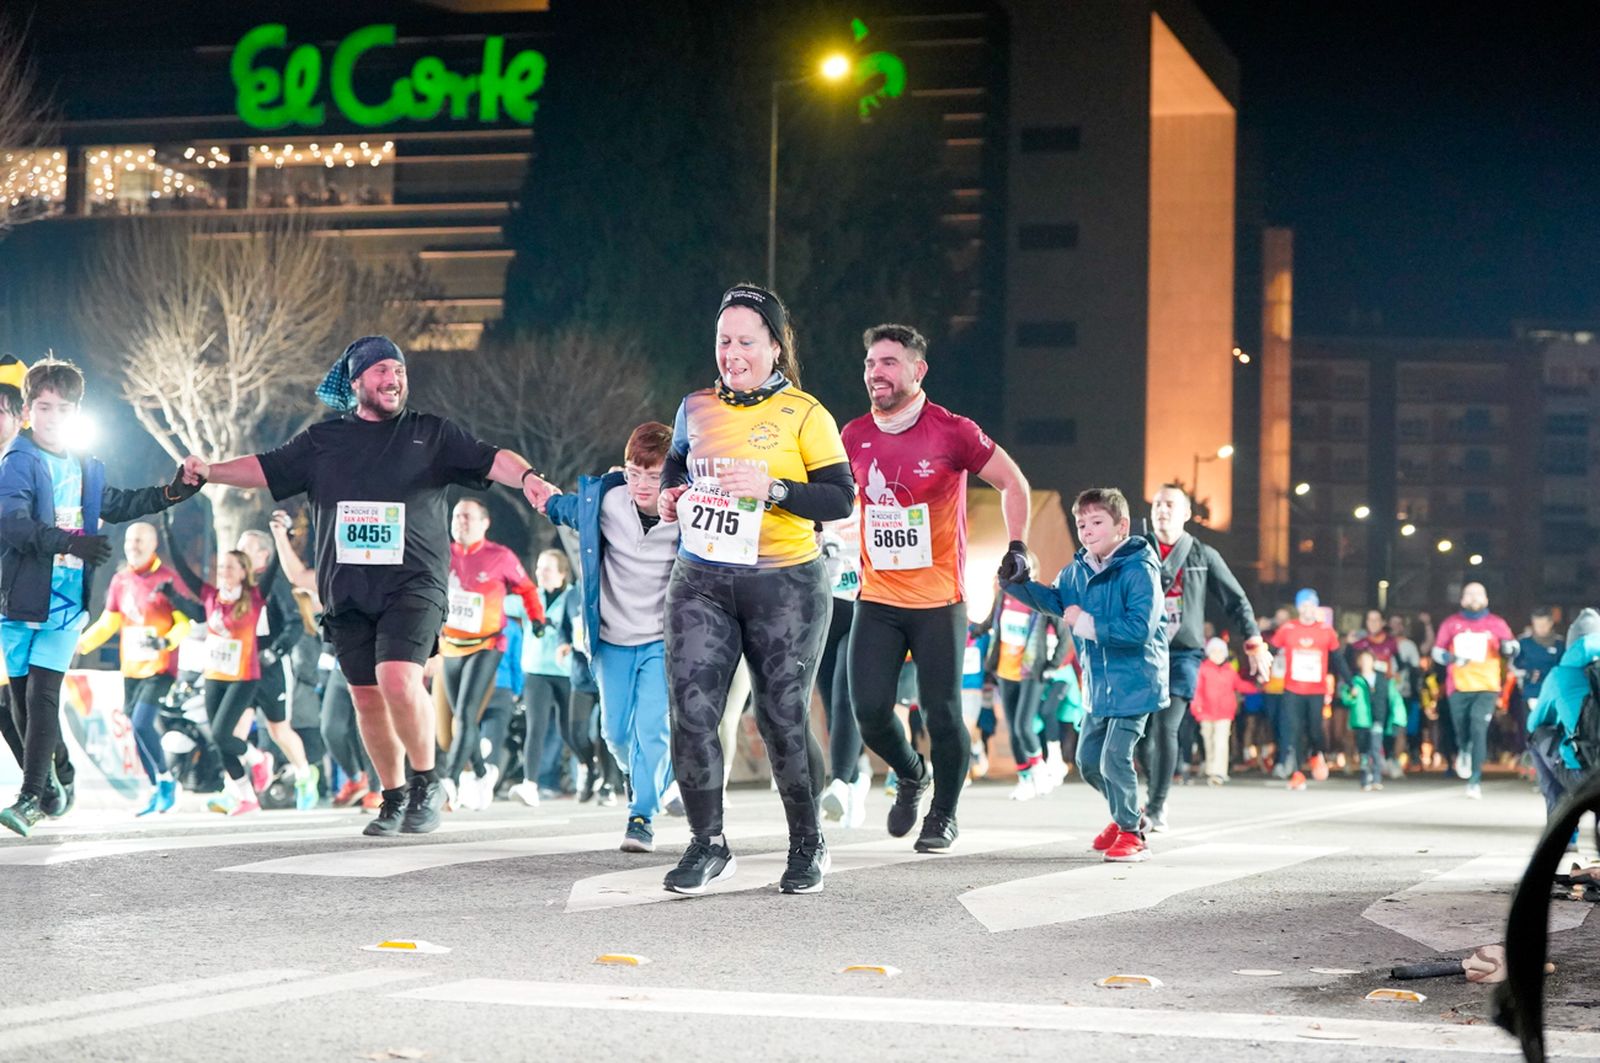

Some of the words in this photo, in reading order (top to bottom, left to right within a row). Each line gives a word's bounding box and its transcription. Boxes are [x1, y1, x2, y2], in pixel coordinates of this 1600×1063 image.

[230, 23, 325, 129] El
[331, 23, 548, 127] Corte
[691, 505, 739, 535] 2715
[347, 524, 391, 543] 8455
[874, 529, 917, 547] 5866
